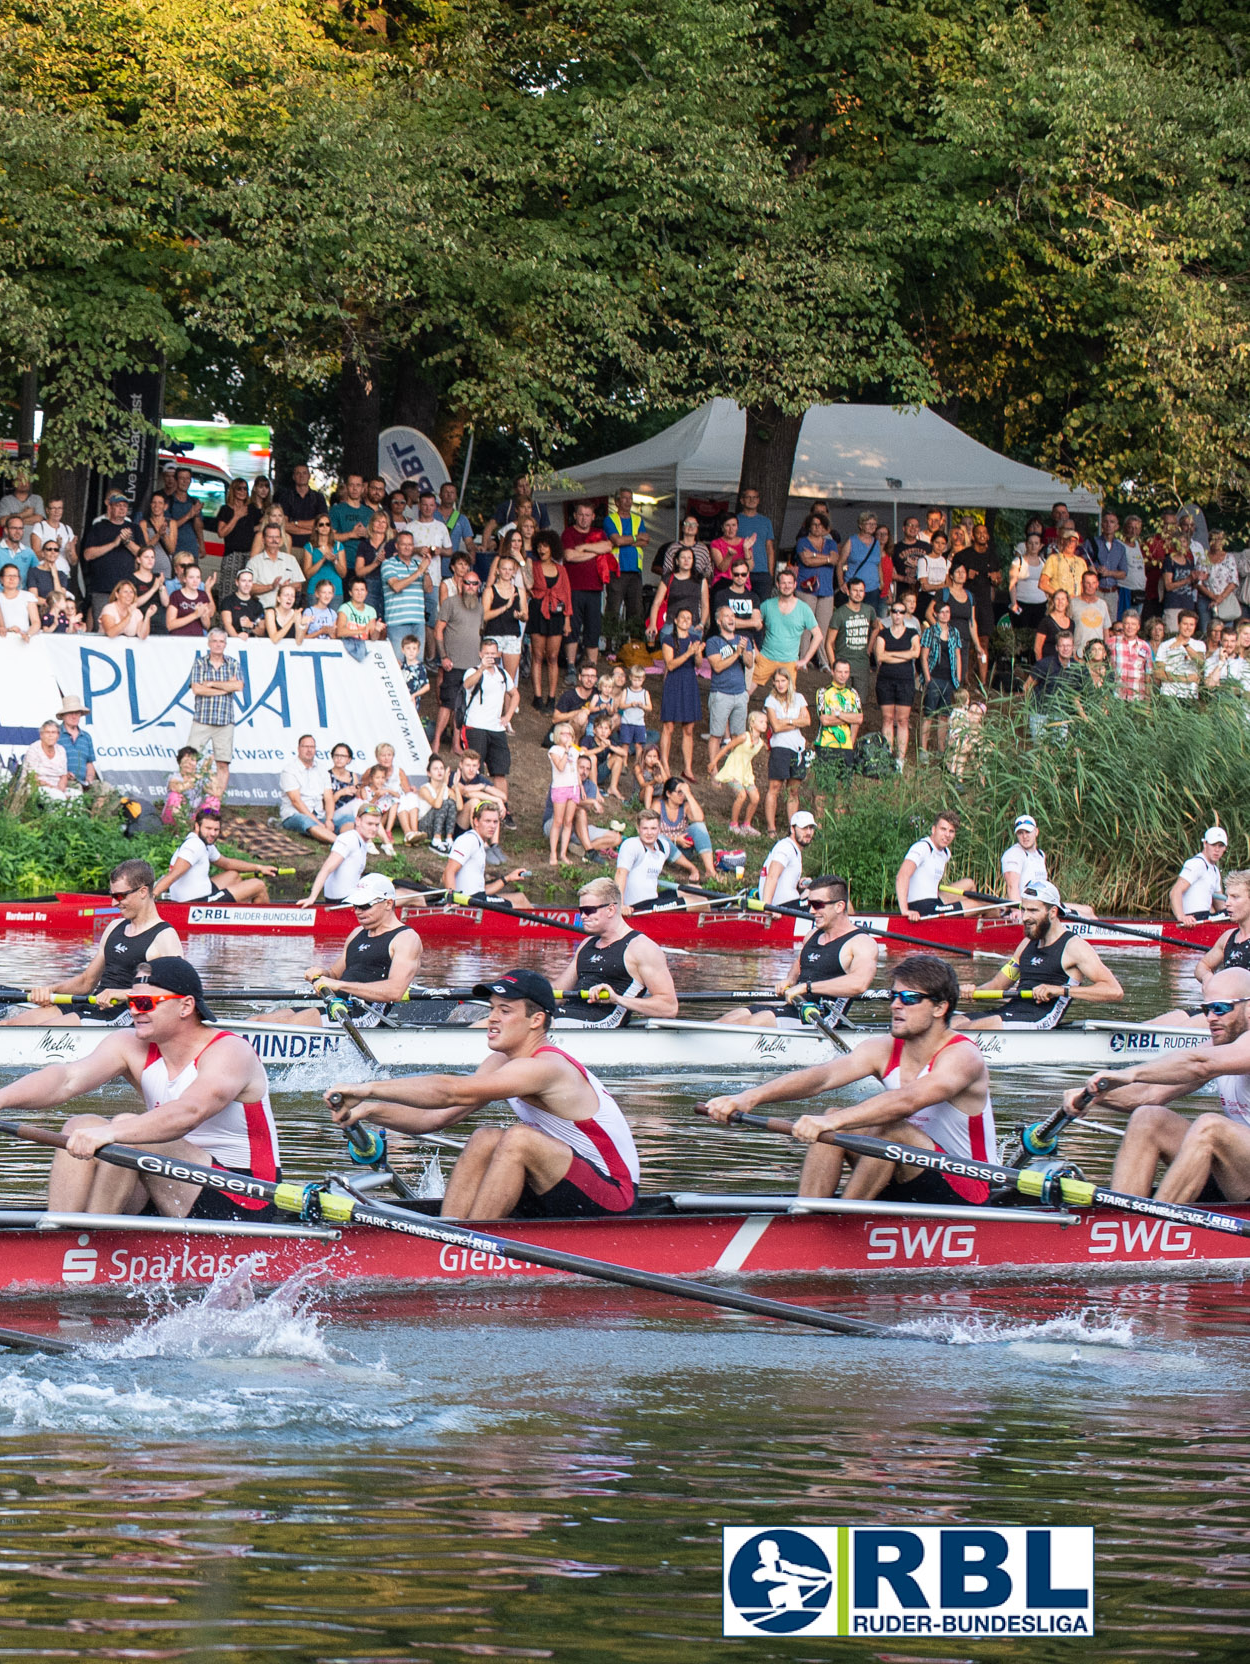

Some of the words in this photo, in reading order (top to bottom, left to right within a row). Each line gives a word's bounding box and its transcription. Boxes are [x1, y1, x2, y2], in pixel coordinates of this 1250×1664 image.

[374, 652, 421, 762] www.planat.de
[97, 743, 178, 758] consultin
[205, 909, 231, 920] RBL
[233, 911, 313, 922] RUDER-BUNDESLIGA
[35, 1029, 77, 1052] Melitta
[241, 1033, 341, 1058] MINDEN
[751, 1034, 787, 1053] Melitta
[1127, 1034, 1160, 1048] RBL
[137, 1156, 265, 1197] Giessen
[884, 1145, 1007, 1183] Sparkasse
[1095, 1192, 1131, 1209] STARK.
[1212, 1215, 1239, 1231] RBL
[354, 1212, 388, 1228] STARK.
[472, 1237, 500, 1254] RBL
[866, 1225, 977, 1260] SWG
[1088, 1220, 1192, 1254] SWG
[109, 1248, 269, 1283] Sparkasse
